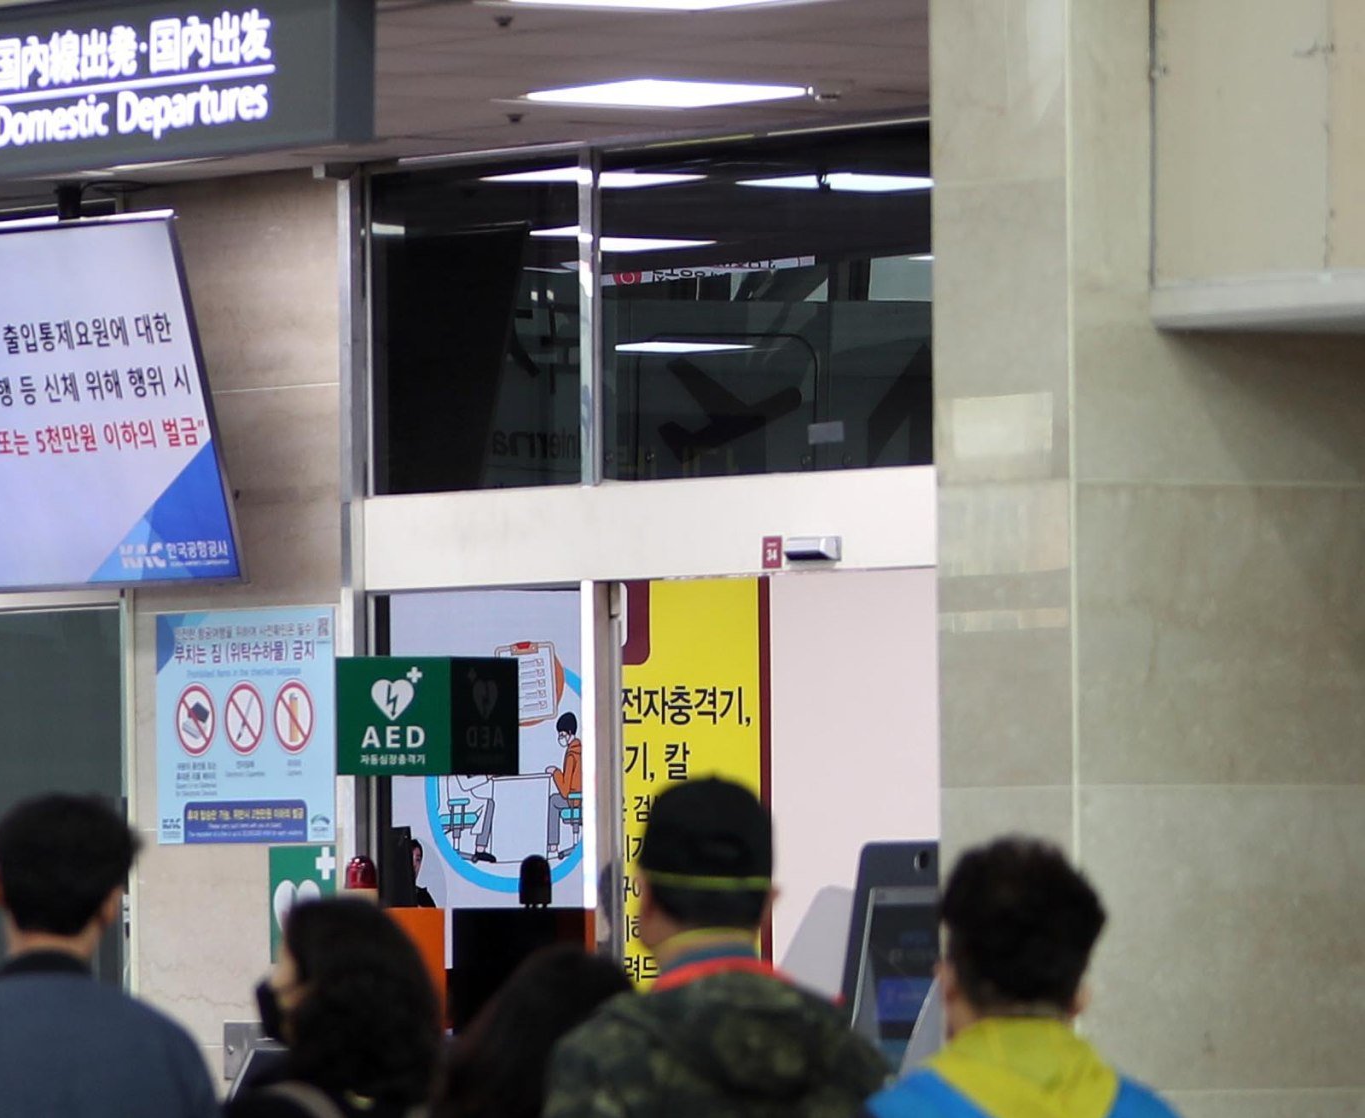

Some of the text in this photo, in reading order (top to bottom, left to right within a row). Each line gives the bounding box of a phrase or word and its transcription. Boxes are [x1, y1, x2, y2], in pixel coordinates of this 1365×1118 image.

[115, 81, 269, 140] Departures
[3, 315, 129, 357] 출입통제요원에
[134, 312, 172, 345] 대한
[19, 374, 37, 406] 등
[43, 371, 79, 403] 신체
[85, 367, 123, 400] 위해
[127, 365, 166, 399] 행위
[173, 362, 192, 396] 시
[35, 423, 98, 456] 5천만원
[103, 418, 156, 452] 이하의
[162, 416, 205, 448] 벌금”
[175, 639, 315, 664] 부치는 짐 (위탁수하물) 금지
[622, 685, 751, 727] 전자충격기,
[361, 725, 425, 749] AED
[360, 753, 426, 766] 자동심장충격기
[665, 741, 690, 780] 칼
